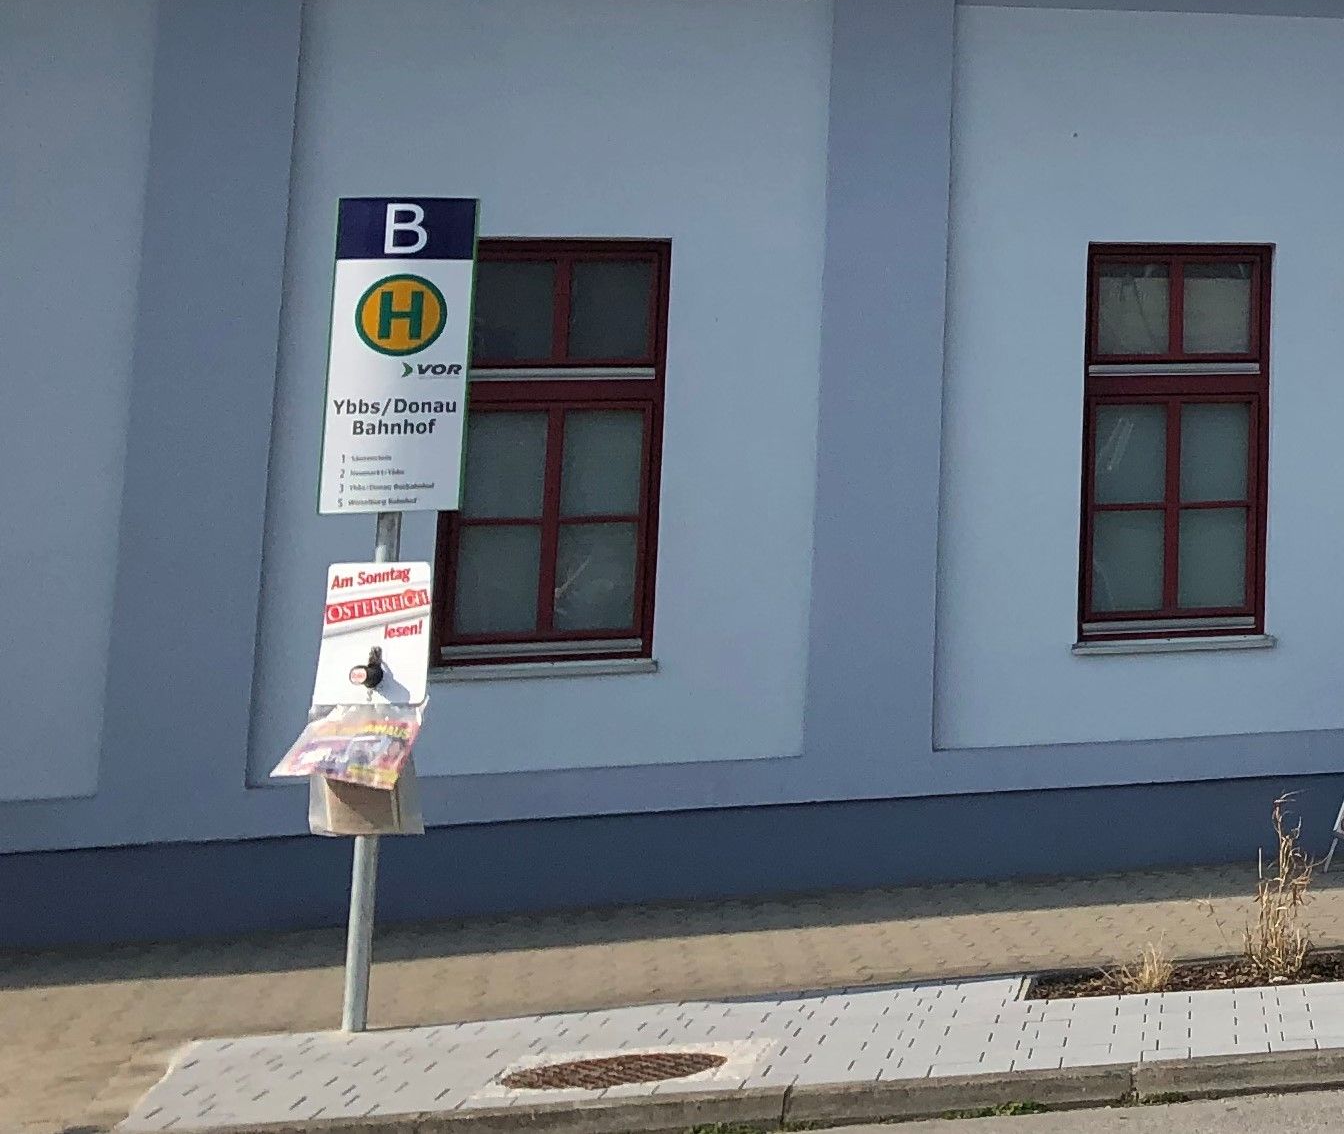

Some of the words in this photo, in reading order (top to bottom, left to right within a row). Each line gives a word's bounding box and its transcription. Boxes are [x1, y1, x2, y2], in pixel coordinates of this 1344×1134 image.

[384, 203, 428, 255] B
[377, 290, 426, 341] H
[417, 363, 462, 376] VOR
[333, 398, 457, 416] Ybbs/Donau
[352, 418, 437, 435] Bahnhof
[332, 575, 353, 590] Am
[357, 567, 411, 586] Sonntag
[384, 620, 423, 639] lesen!
